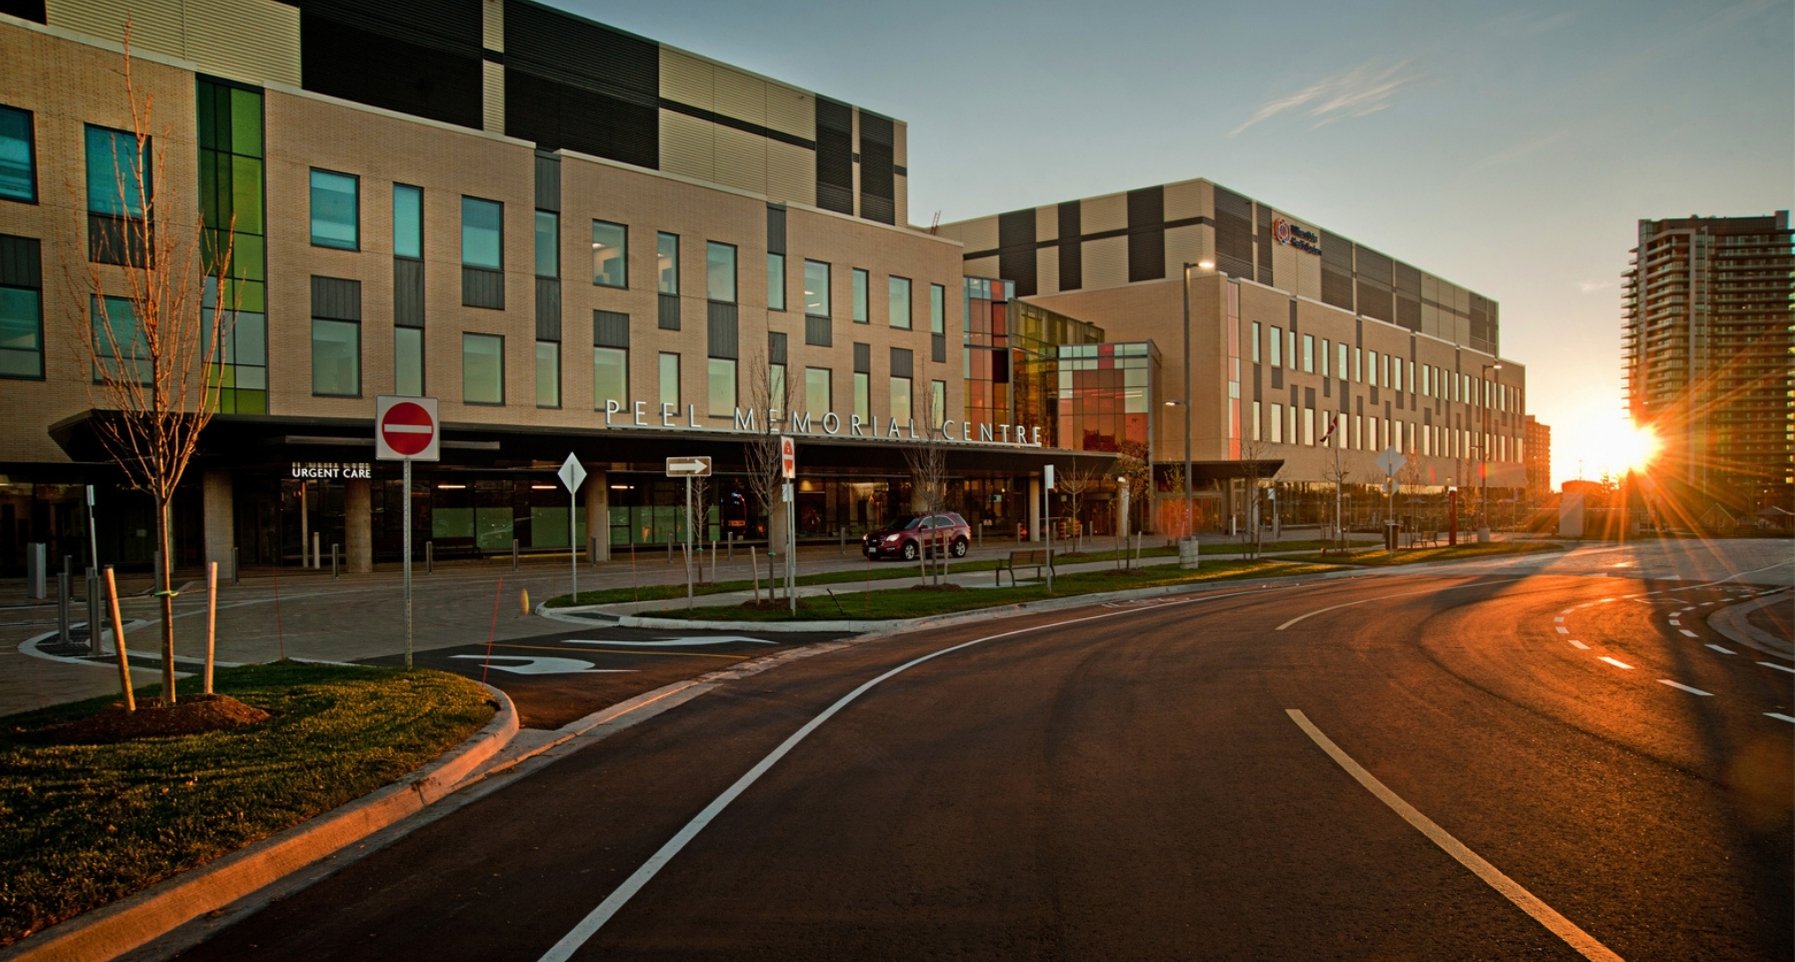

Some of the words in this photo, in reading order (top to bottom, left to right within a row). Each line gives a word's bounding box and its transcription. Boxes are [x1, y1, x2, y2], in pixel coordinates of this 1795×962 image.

[605, 399, 702, 428] PEEL
[734, 406, 920, 439] MEMORIAL
[942, 419, 1042, 446] CENTRE
[291, 467, 340, 478] URGENT
[342, 468, 372, 478] CARE
